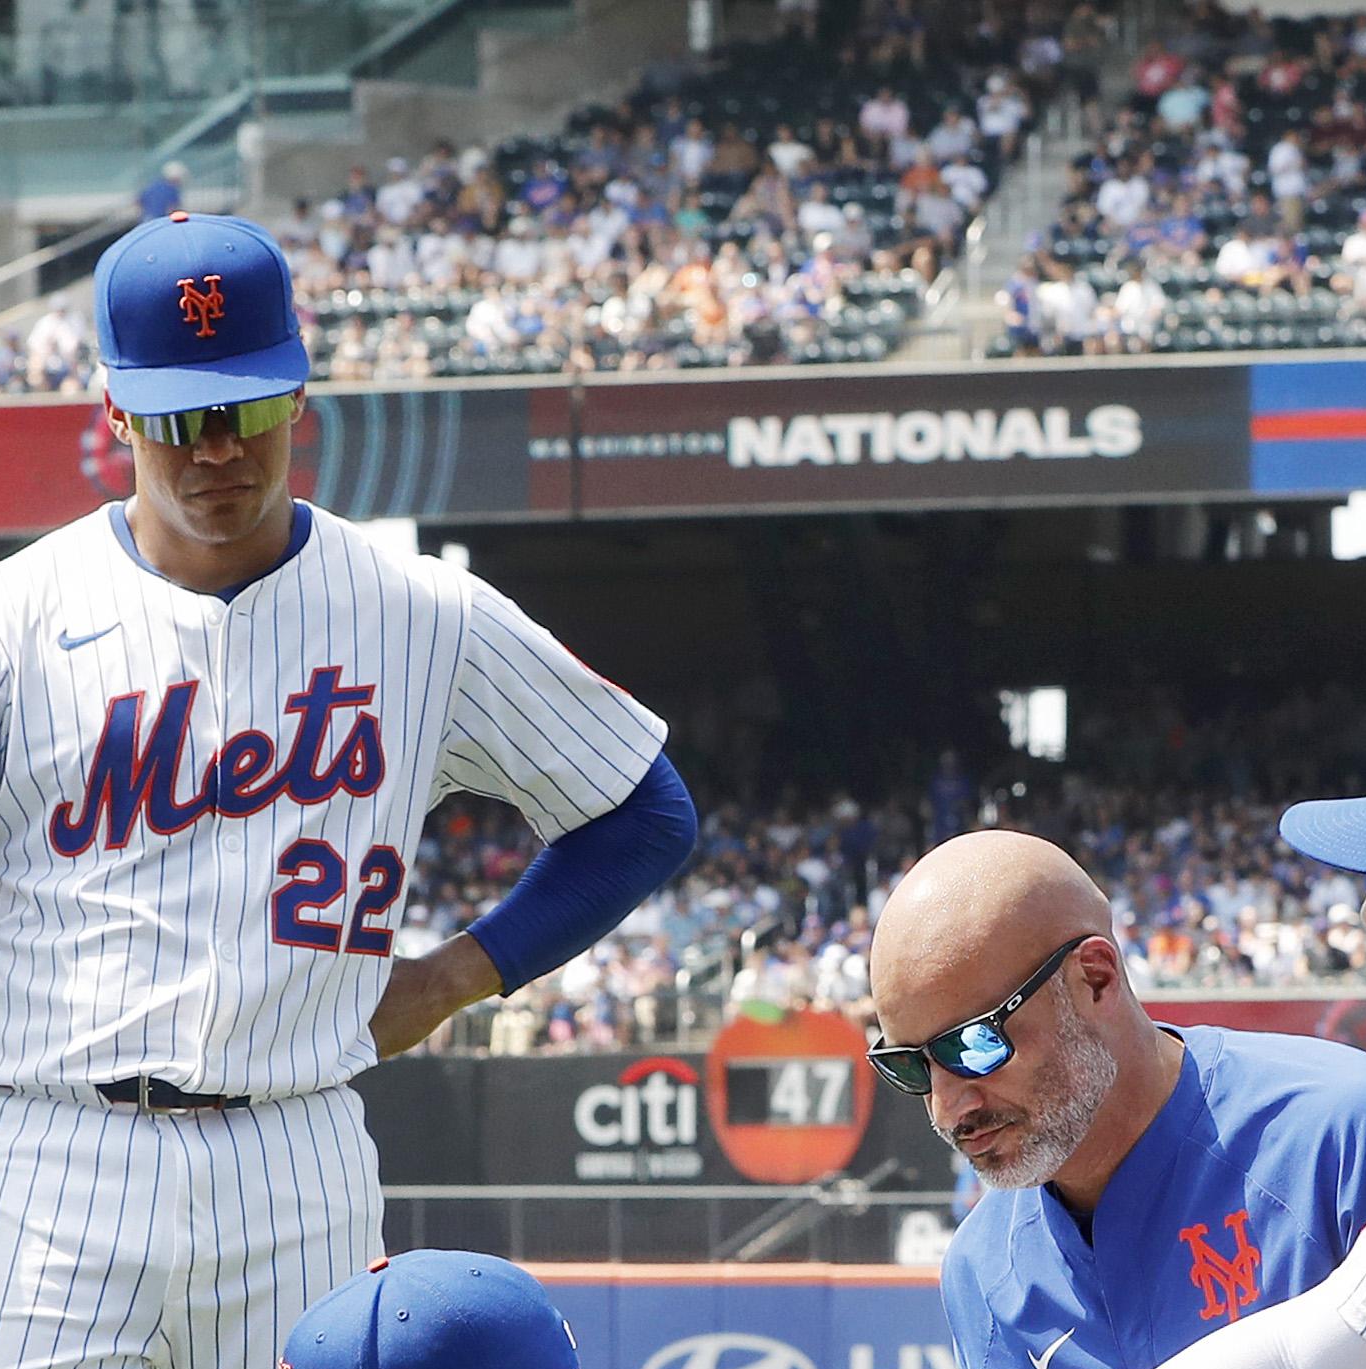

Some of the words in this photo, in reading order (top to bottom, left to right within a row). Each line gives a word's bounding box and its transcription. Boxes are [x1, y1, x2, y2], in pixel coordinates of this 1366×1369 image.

[727, 403, 1143, 468] NATIONALS
[49, 665, 386, 858] Mets
[271, 837, 406, 958] 22
[574, 1070, 698, 1146] citi
[769, 1060, 852, 1125] 47
